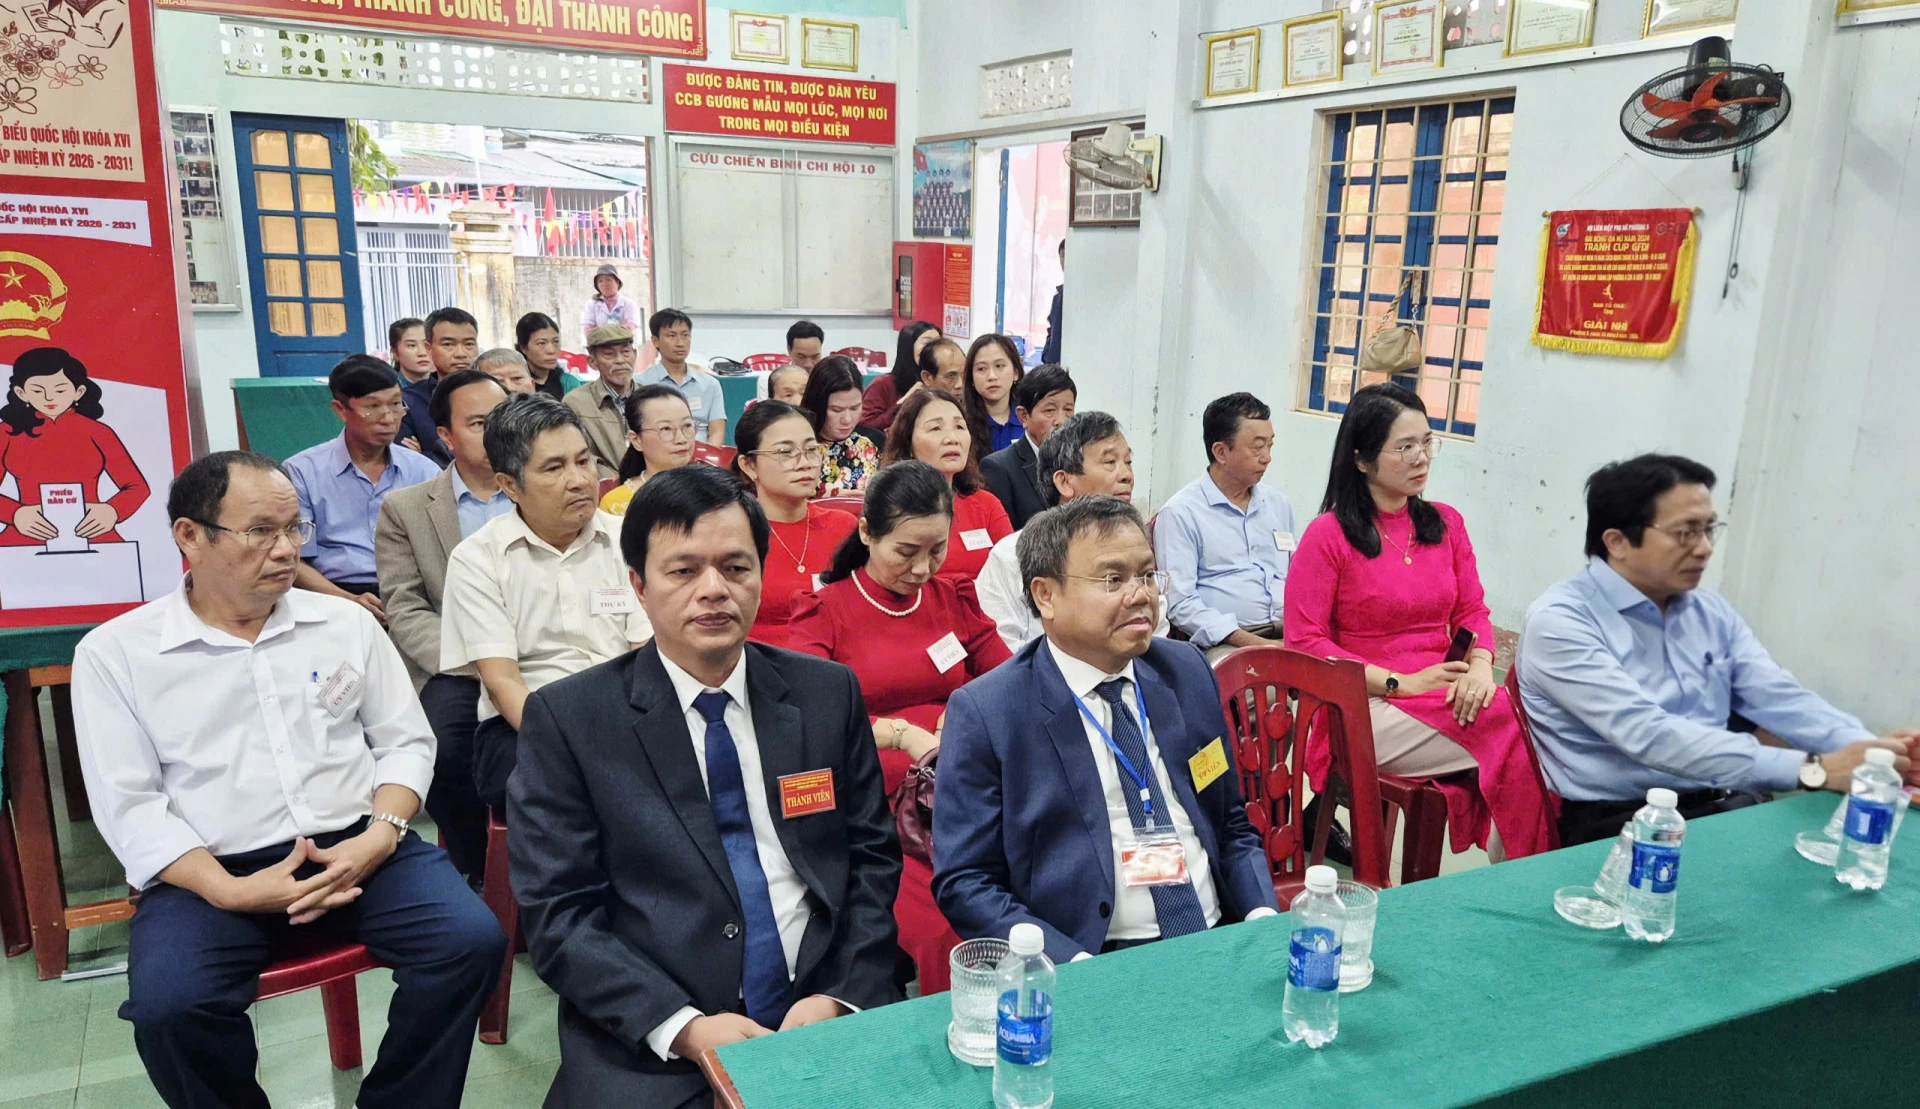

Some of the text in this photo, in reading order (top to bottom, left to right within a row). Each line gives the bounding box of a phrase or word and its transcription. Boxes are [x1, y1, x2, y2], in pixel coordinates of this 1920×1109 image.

[516, 0, 554, 33] ĐẠI
[560, 0, 631, 35] THÀNH
[637, 5, 694, 42] CÔNG
[686, 73, 877, 101] ĐƯỢC ĐẢNG TIN, ĐƯỢC DÂN YÊU
[675, 92, 888, 122] CCB GƯƠNG MẪU MỌI LÚC, MỌI NƠI
[3, 121, 131, 148] BIỂU QUỐC HỘI KHÓA XVI
[718, 115, 851, 137] TRONG MỌI ĐIỀU KIỆN
[14, 148, 49, 168] NHIỆM
[52, 149, 65, 167] KỲ
[69, 153, 94, 168] 2026
[104, 155, 133, 171] 2031!
[690, 153, 719, 166] CỰU
[807, 161, 829, 172] CHI
[833, 160, 856, 174] HỘI
[861, 164, 876, 175] 10
[19, 203, 37, 215] HỘI
[40, 205, 69, 214] KHÓA
[71, 207, 89, 215] XVI
[22, 216, 57, 227] NHIỆM
[60, 217, 74, 227] KỲ
[77, 220, 102, 228] 2026
[1584, 242, 1611, 252] TRANH
[1613, 242, 1630, 252] CUP
[1583, 318, 1608, 330] GIẢI
[785, 792, 812, 808] THÀNH
